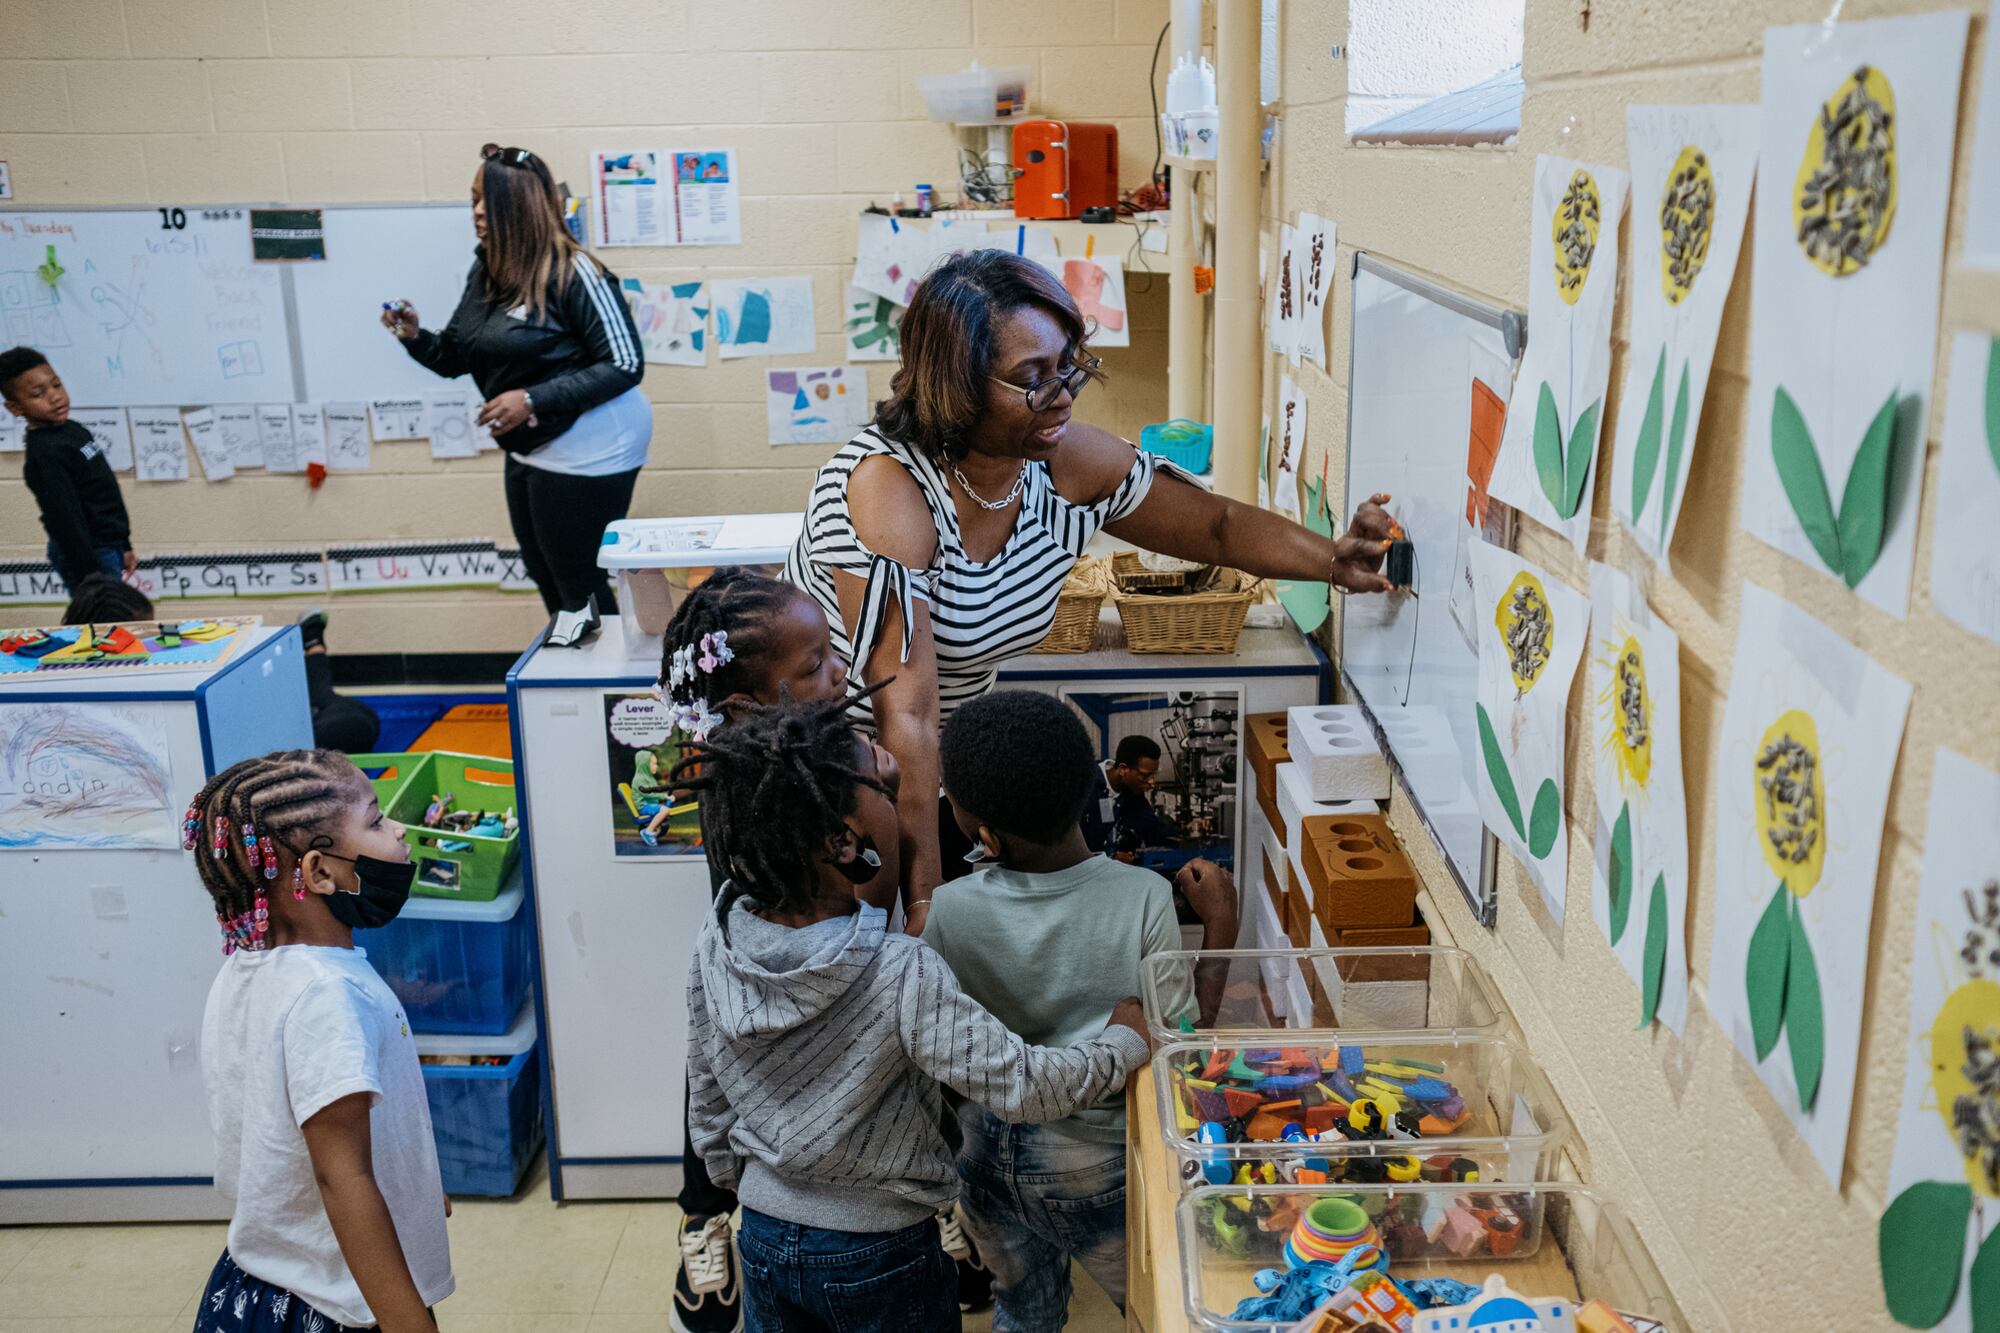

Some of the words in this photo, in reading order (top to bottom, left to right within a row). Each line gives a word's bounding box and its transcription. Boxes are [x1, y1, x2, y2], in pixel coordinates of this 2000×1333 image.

[158, 207, 186, 230] 10
[162, 567, 191, 598] Pp
[201, 565, 237, 597] Qq
[246, 565, 275, 587] Rr
[290, 564, 318, 586] Ss
[336, 558, 361, 581] Tt
[377, 557, 409, 580] Uu
[419, 554, 449, 577] Vv
[457, 552, 496, 575] Ww
[626, 704, 654, 713] Lever
[0, 773, 109, 800] andyn
[1323, 1275, 1341, 1289] 40
